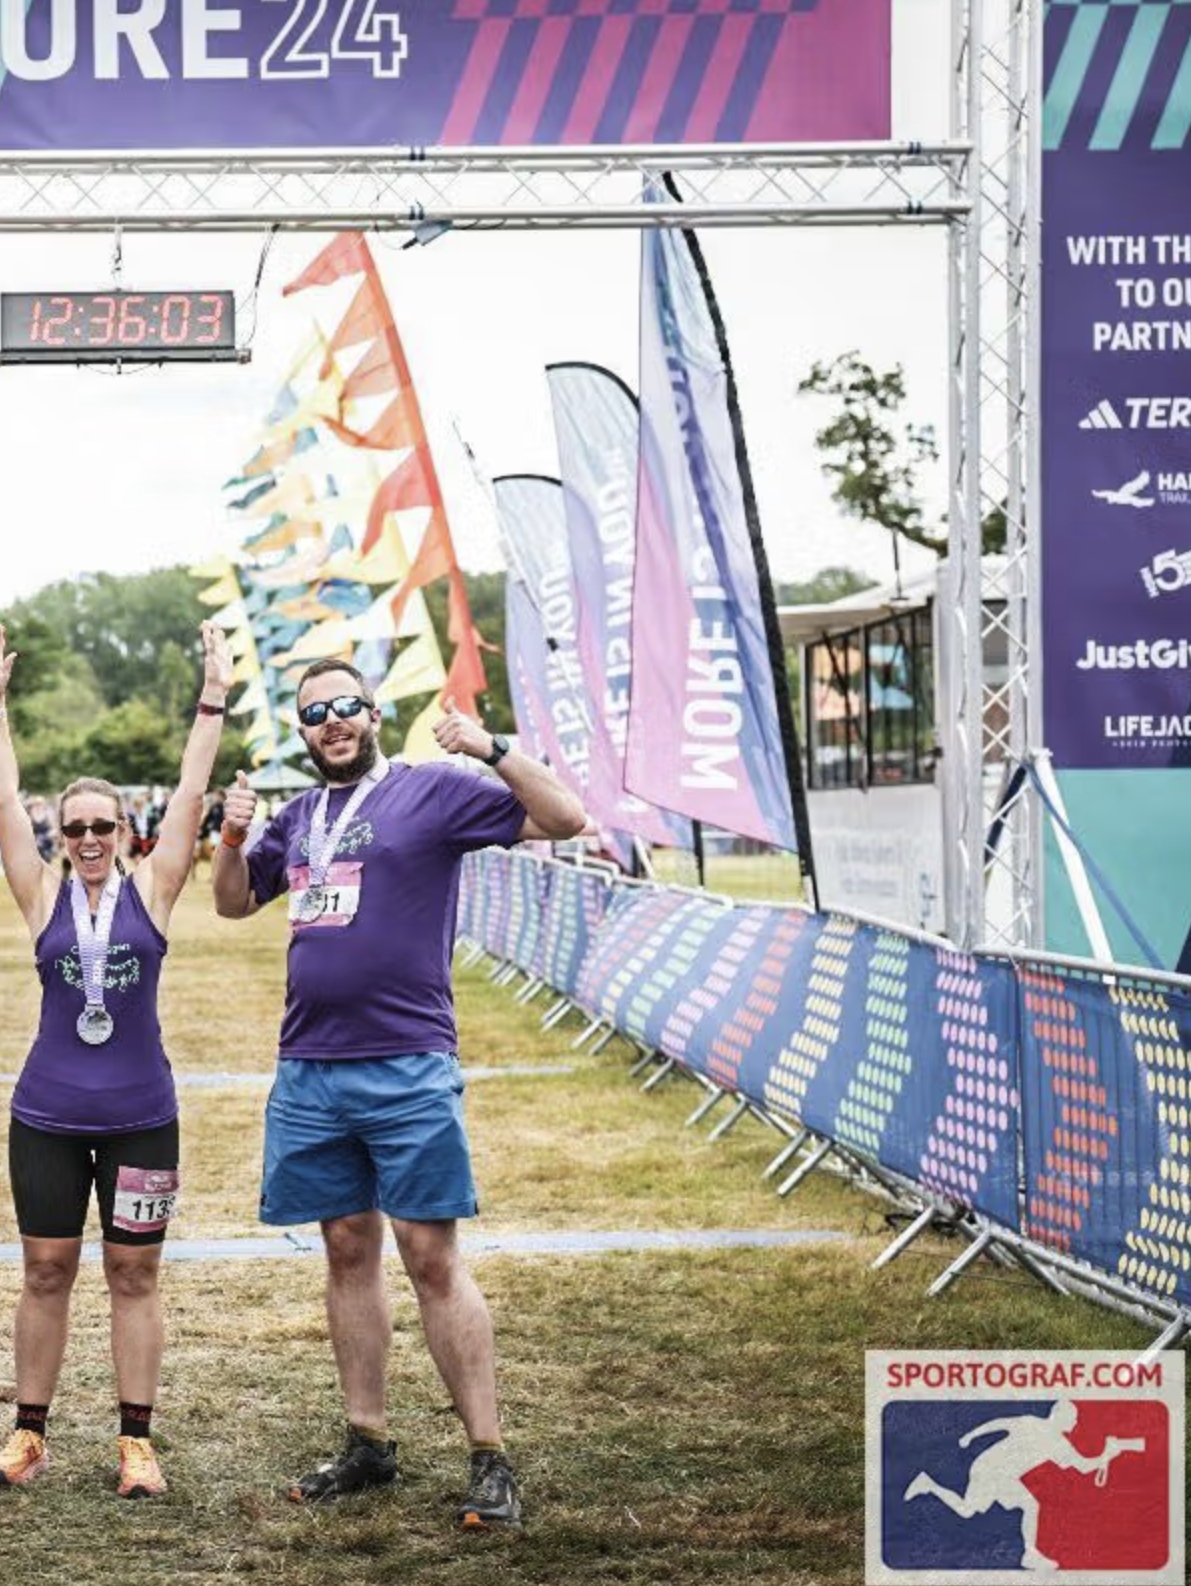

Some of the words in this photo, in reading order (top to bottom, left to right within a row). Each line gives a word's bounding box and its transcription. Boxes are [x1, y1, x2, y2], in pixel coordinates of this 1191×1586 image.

[1066, 235, 1146, 265] WITH
[1116, 279, 1156, 309] TO
[30, 295, 223, 345] 12:36:03
[1093, 321, 1191, 351] PARTN
[1158, 472, 1191, 491] HA
[1076, 639, 1191, 669] JustGi
